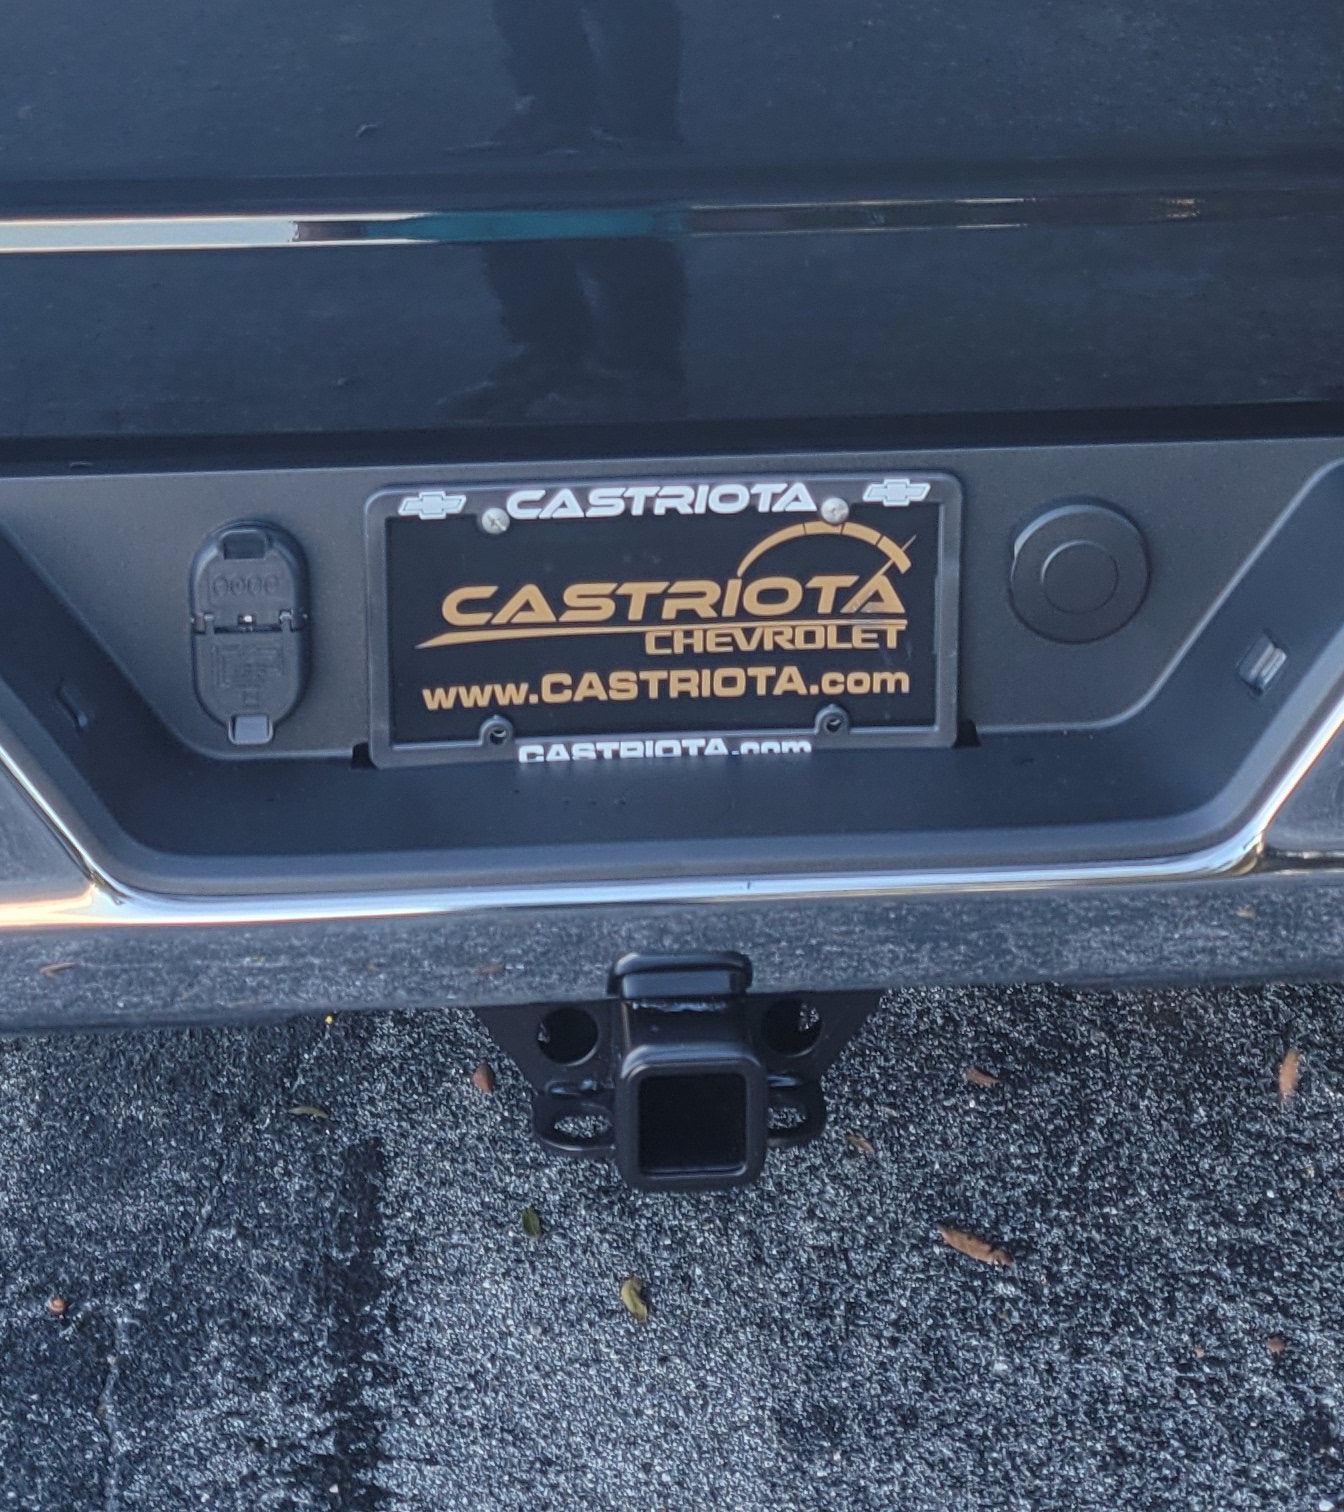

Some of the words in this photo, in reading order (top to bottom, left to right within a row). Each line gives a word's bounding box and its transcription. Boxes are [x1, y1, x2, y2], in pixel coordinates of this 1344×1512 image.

[506, 483, 817, 519] CASTRIOTA
[441, 574, 905, 626] CASTRIOTA
[645, 625, 906, 655] CHEVROLET
[422, 666, 910, 710] www.CASTRIOTA.com
